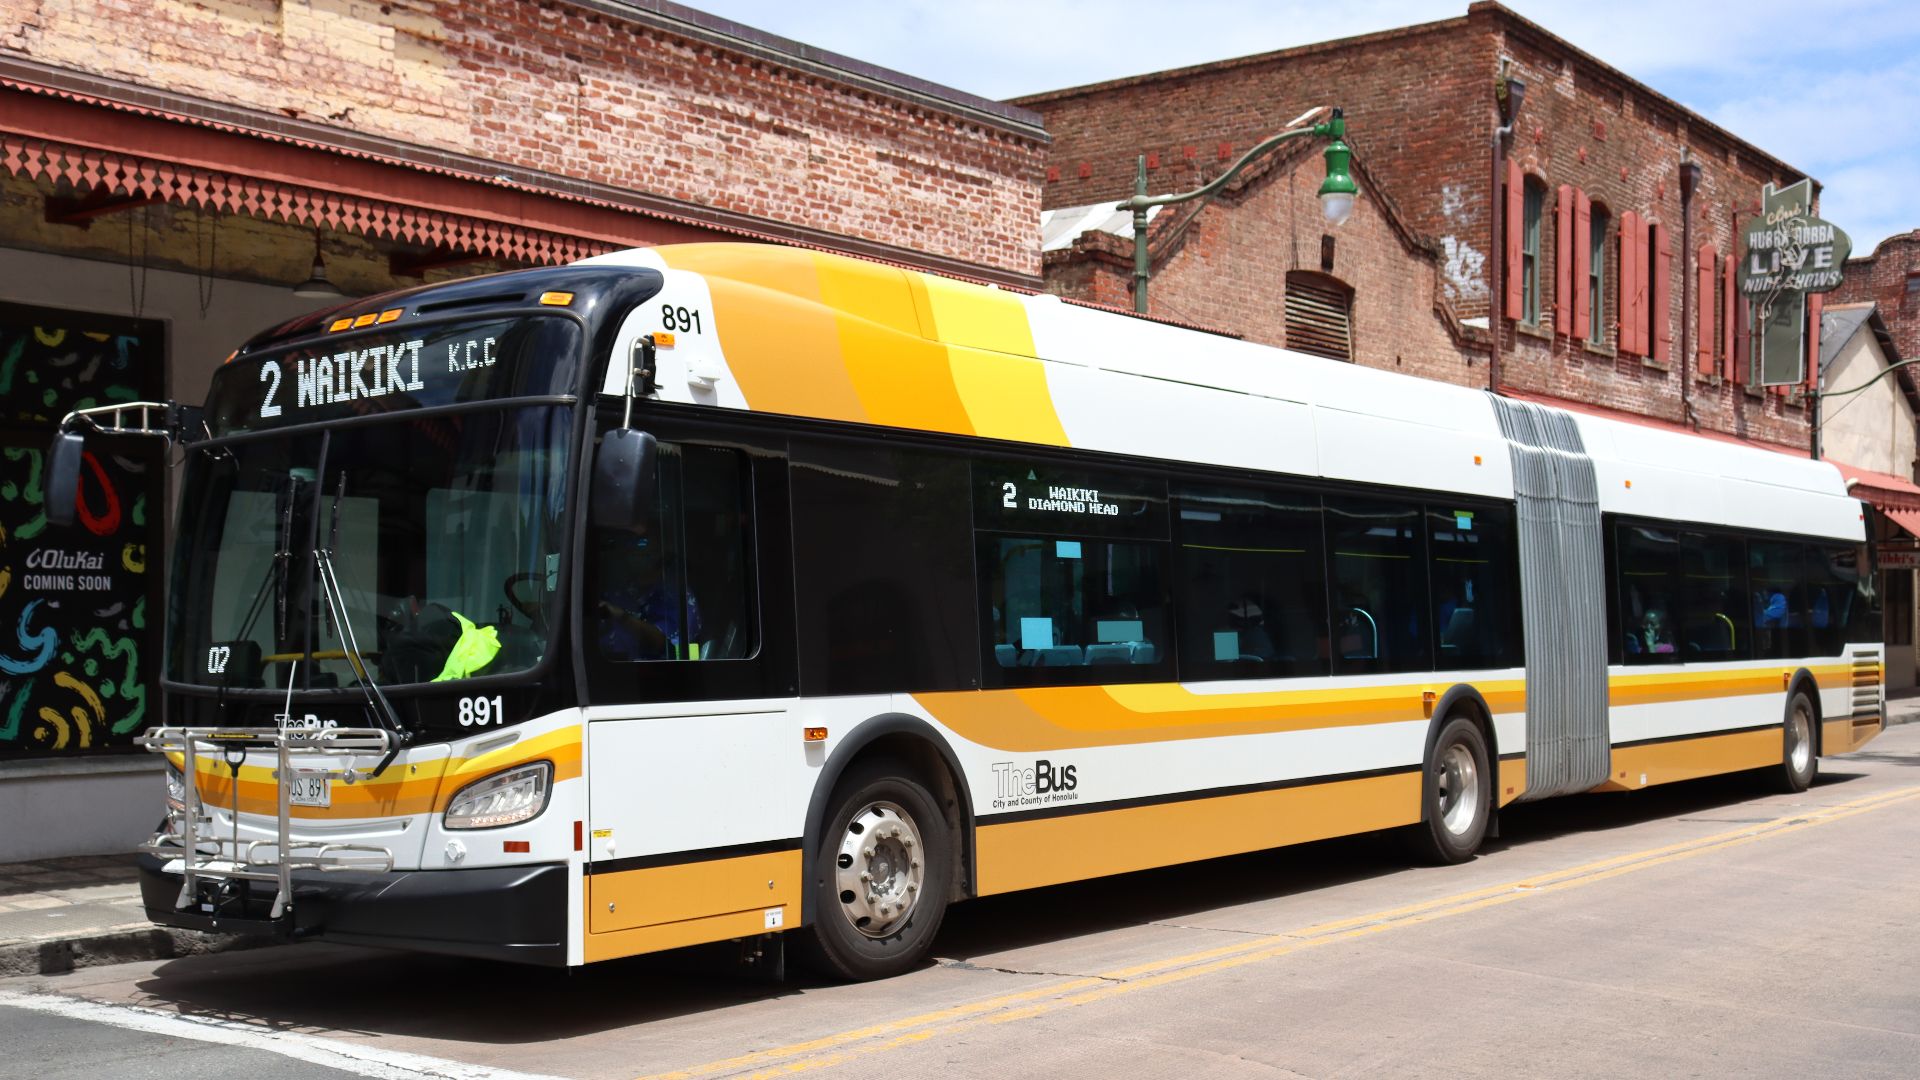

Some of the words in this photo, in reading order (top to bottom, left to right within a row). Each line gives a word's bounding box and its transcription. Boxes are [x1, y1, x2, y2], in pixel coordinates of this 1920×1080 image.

[1749, 229, 1788, 250] HUBBA
[1751, 246, 1834, 275] LIVE
[662, 303, 701, 335] 891
[260, 360, 282, 418] 2
[297, 339, 424, 408] WAIKIKI
[1002, 482, 1018, 509] 2
[1048, 486, 1099, 503] WAIKIKI
[1028, 497, 1086, 513] DIAMOND
[1088, 502, 1119, 516] HEAD
[41, 549, 104, 570] OluKai
[23, 574, 75, 591] COMING
[77, 575, 112, 591] SOON
[458, 695, 503, 727] 891
[309, 777, 327, 800] 891
[991, 759, 1078, 798] TheBus
[992, 799, 1006, 810] City
[1007, 798, 1019, 807] and
[1020, 795, 1043, 806] County
[1044, 794, 1051, 803] of
[1052, 791, 1079, 802] Honolulu
